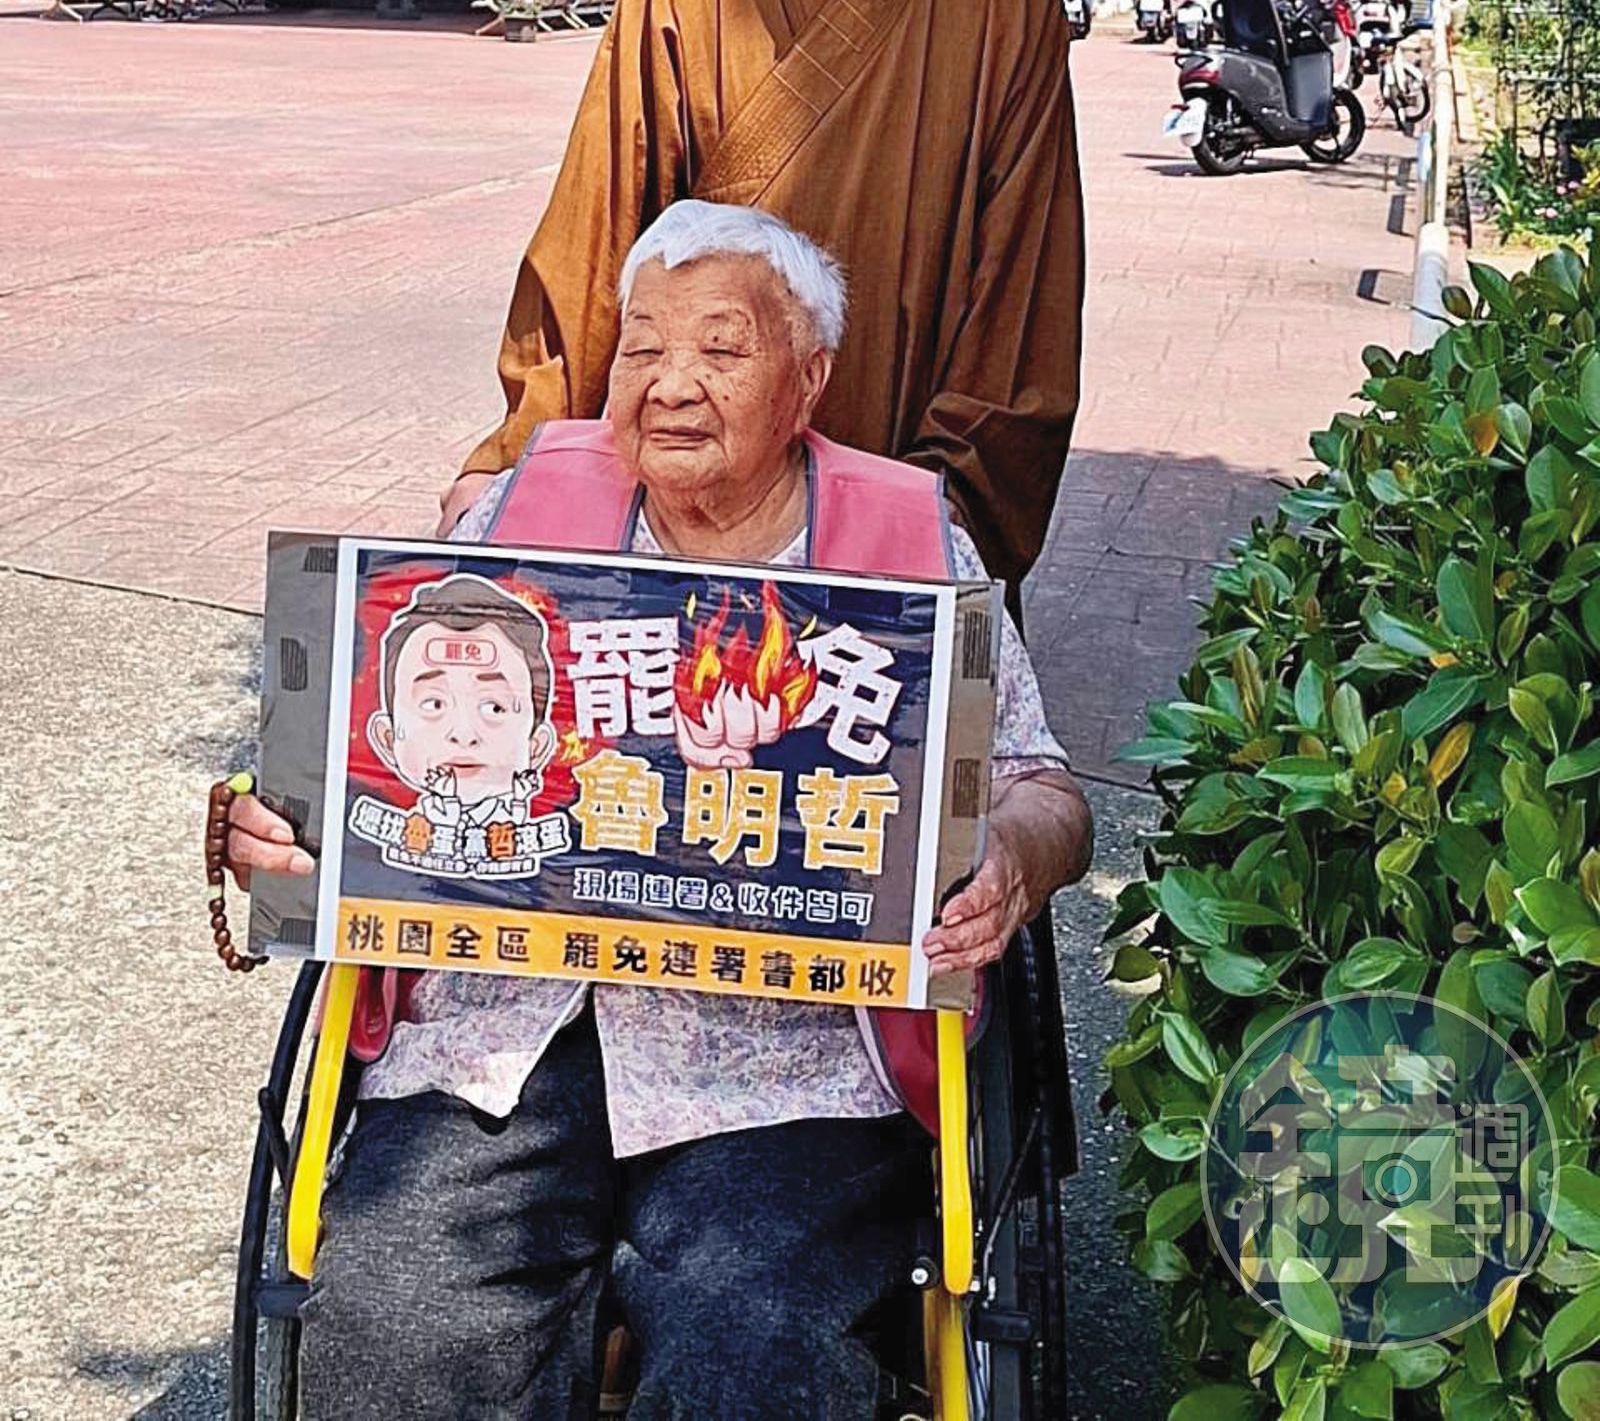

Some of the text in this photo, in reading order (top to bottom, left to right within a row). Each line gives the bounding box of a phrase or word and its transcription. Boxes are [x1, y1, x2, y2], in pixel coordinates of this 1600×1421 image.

[569, 750, 900, 875] 魯明哲
[573, 868, 874, 925] 現場連署&收件皆可
